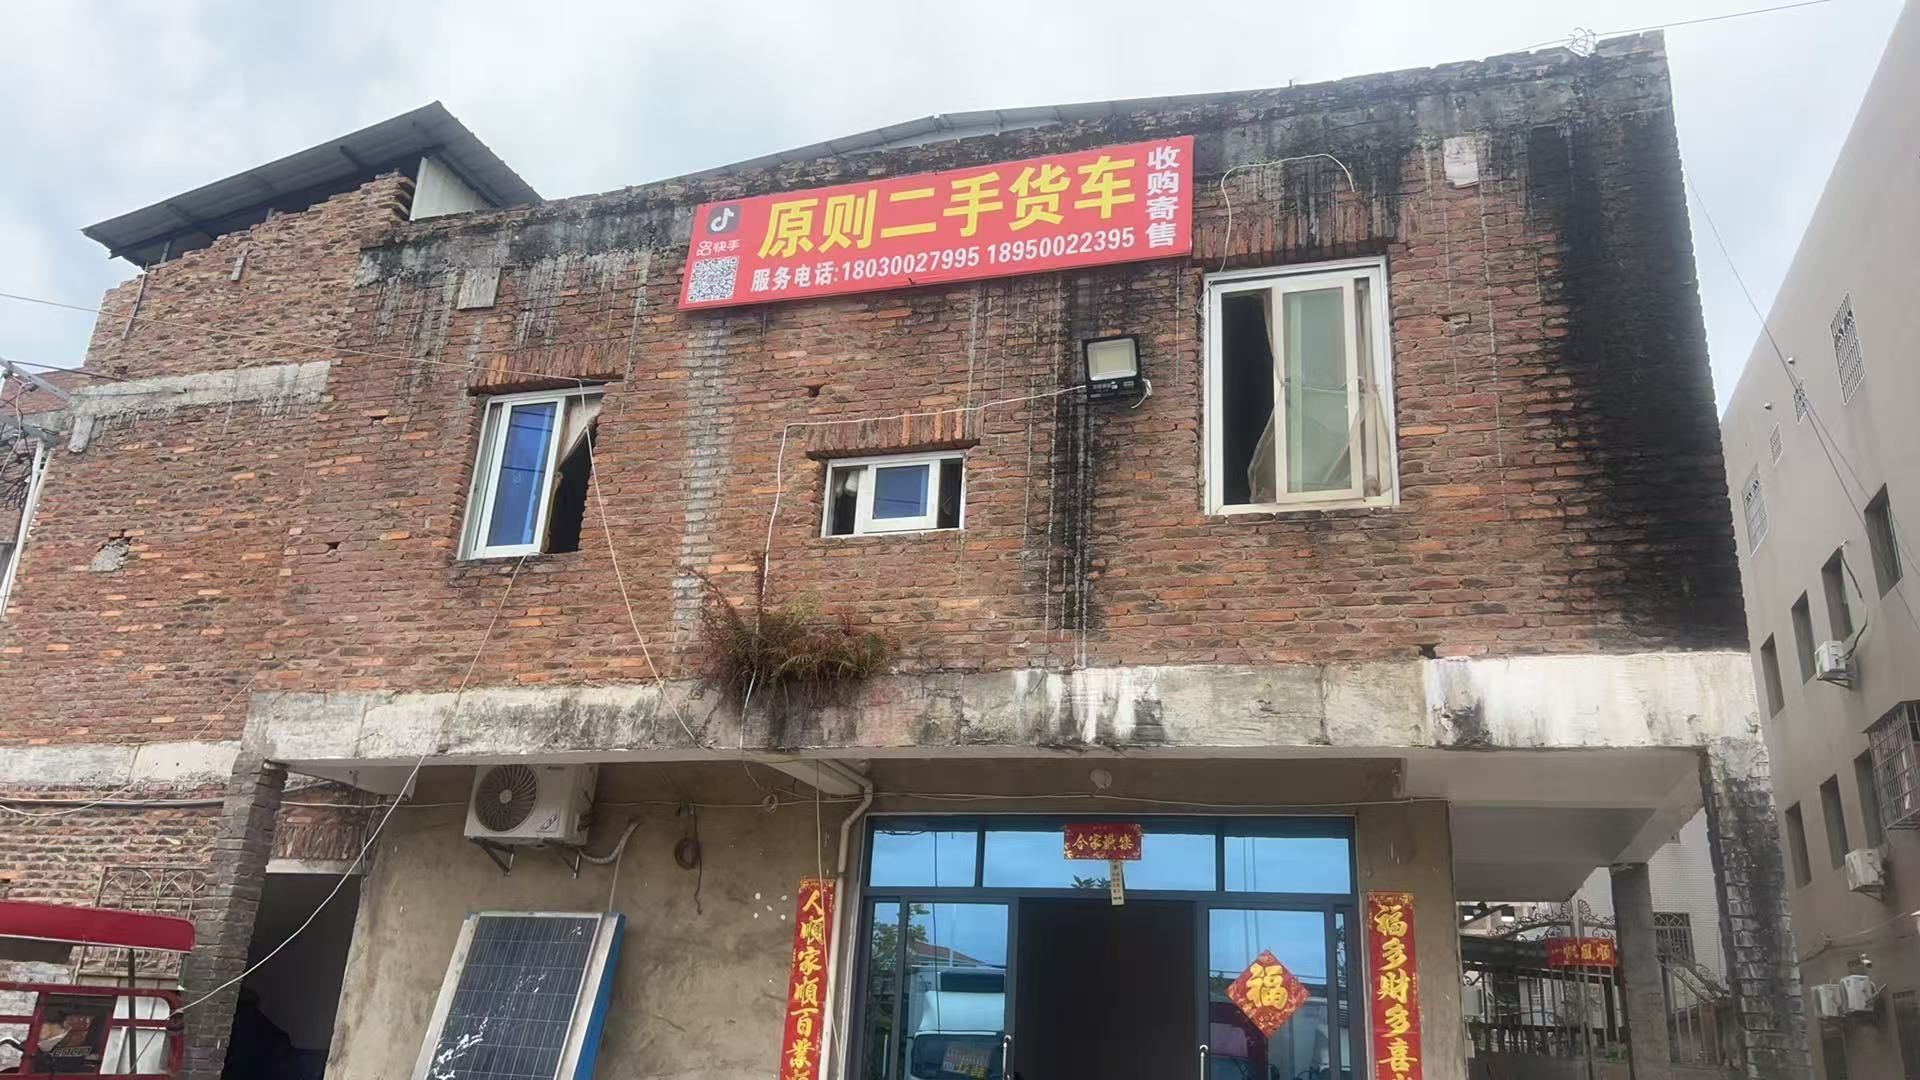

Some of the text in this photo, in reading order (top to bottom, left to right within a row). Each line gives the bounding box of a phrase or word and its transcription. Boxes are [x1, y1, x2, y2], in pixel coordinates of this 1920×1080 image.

[758, 155, 1136, 260] 原则二手货车
[1145, 146, 1181, 249] 收购寄售
[713, 239, 741, 253] 快手
[987, 226, 1135, 265] 18950022395
[1246, 963, 1288, 1010] 福
[1374, 903, 1417, 1080] 福多財多喜
